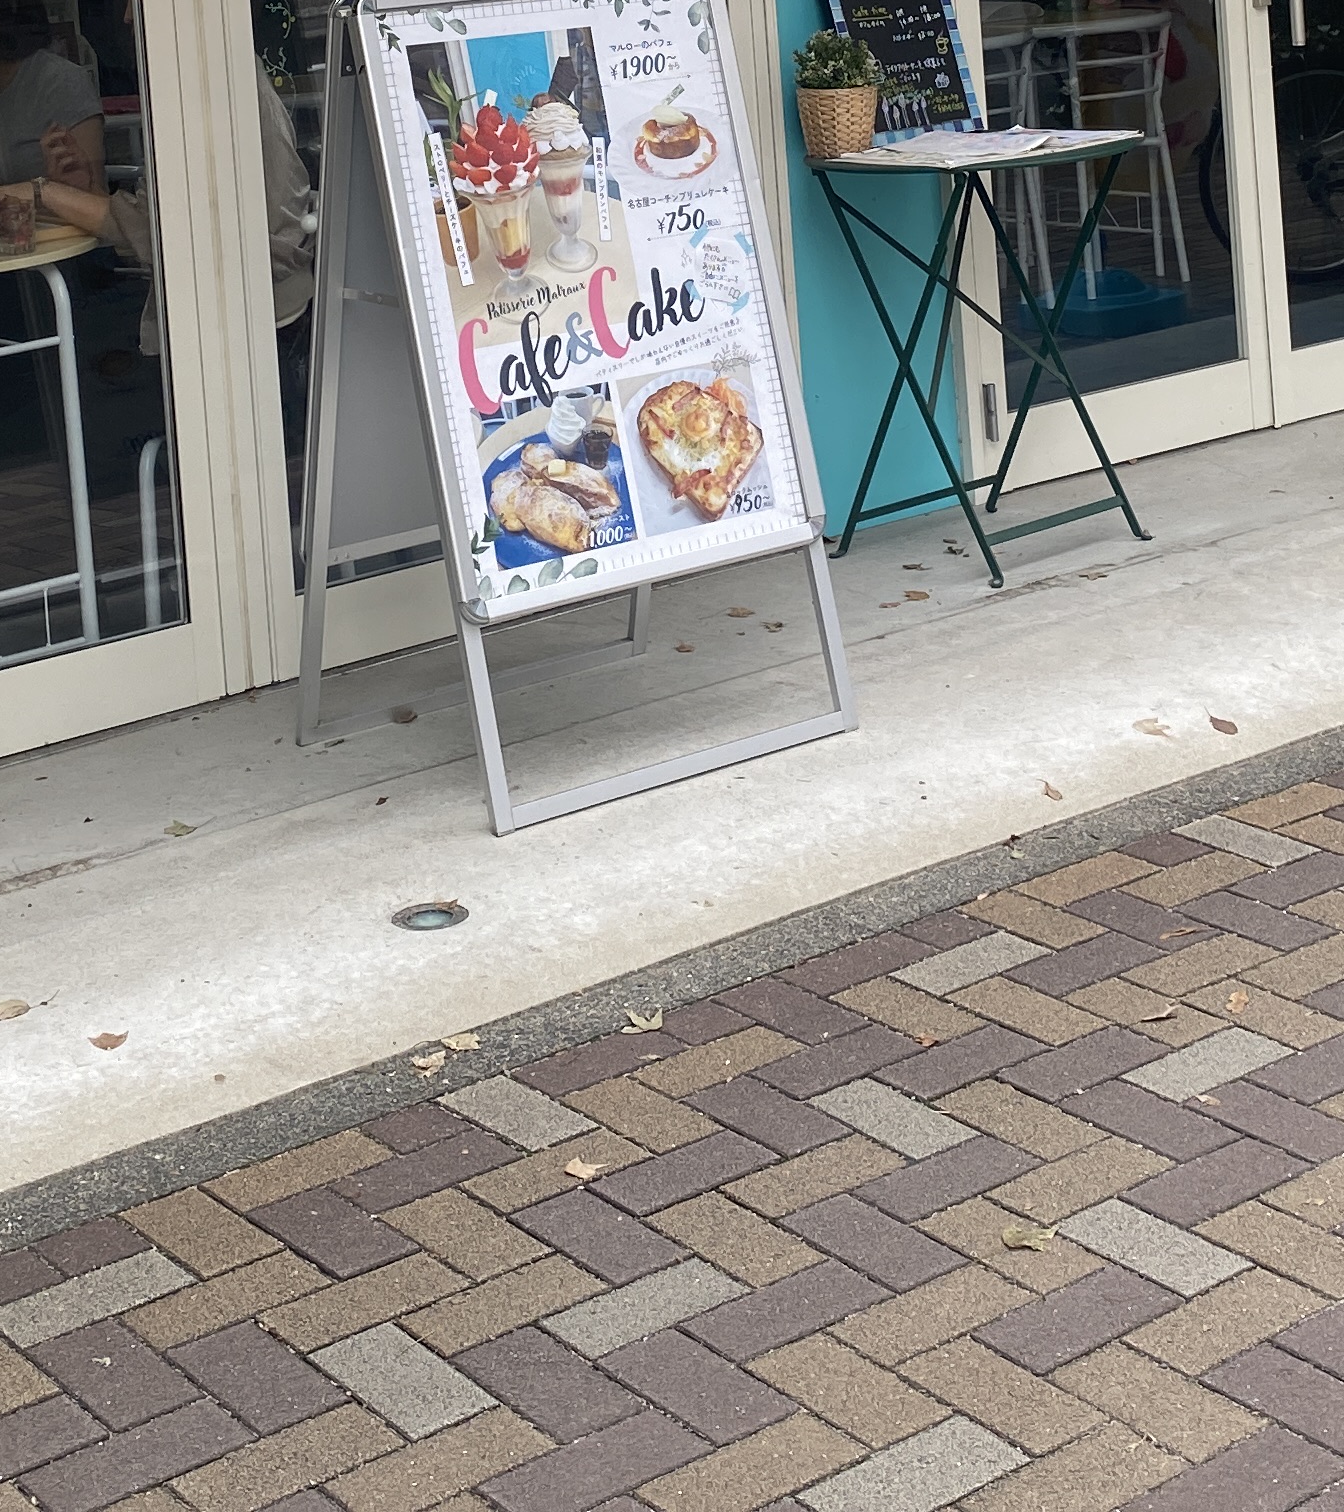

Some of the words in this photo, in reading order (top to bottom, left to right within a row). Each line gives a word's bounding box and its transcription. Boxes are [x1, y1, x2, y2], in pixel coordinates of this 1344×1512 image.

[656, 202, 705, 235] ¥750
[485, 294, 536, 321] Patisserie
[535, 281, 587, 306] Malraux
